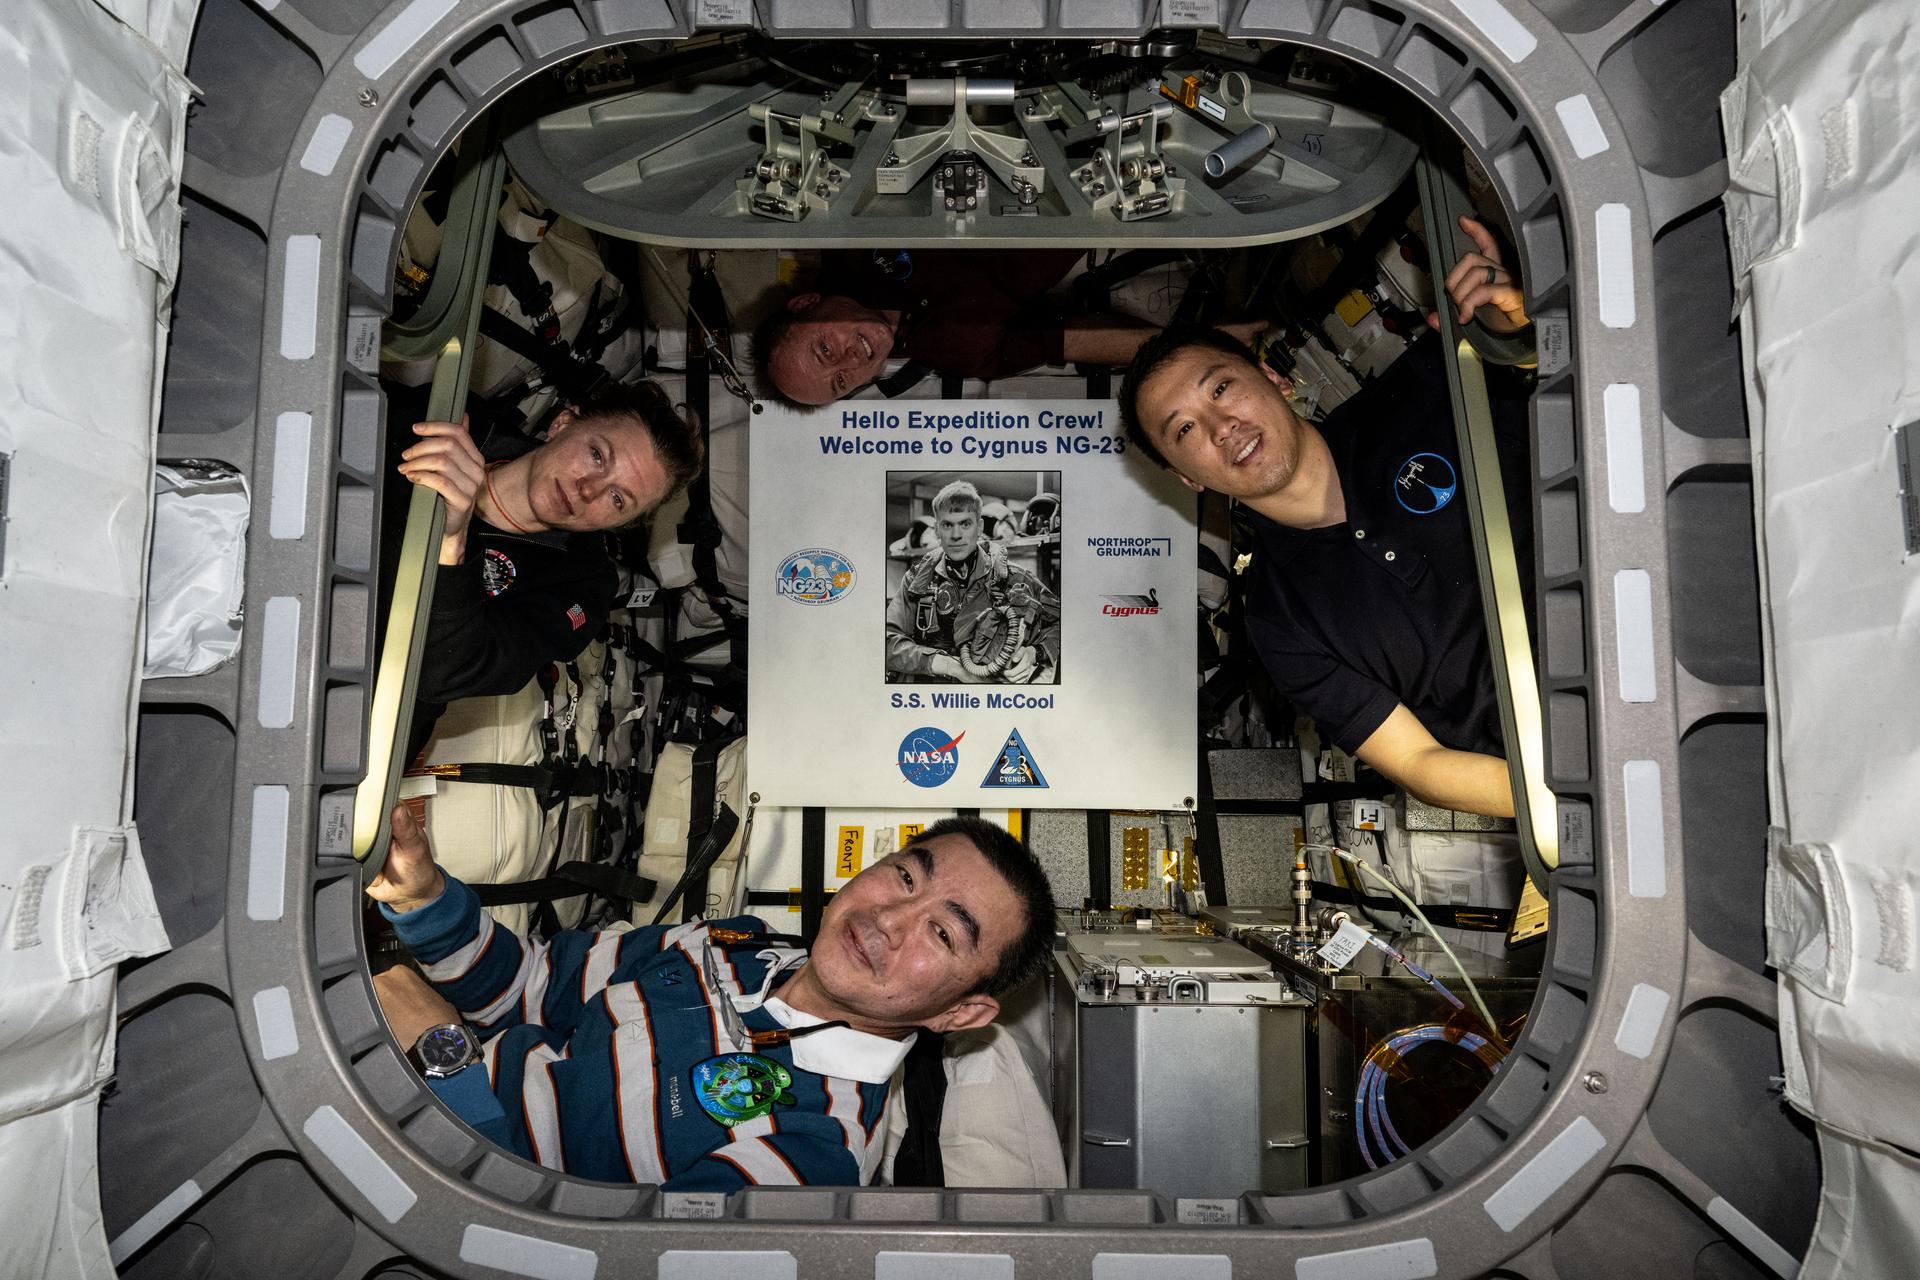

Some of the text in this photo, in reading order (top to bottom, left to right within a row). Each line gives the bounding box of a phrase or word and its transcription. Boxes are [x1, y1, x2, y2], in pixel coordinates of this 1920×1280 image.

[842, 410, 1103, 433] Hello Expedition Crew!
[819, 436, 1126, 459] Welcome to Cygnus NG-23
[1087, 537, 1152, 547] NORTHROP
[1096, 547, 1161, 557] GRUMMAN
[777, 577, 827, 595] NG-23
[1102, 604, 1159, 618] Cygnus
[890, 692, 1054, 709] S.S. Willie McCool
[903, 750, 956, 764] NASA
[1000, 755, 1028, 775] 23
[1360, 808, 1379, 823] F1
[841, 830, 859, 873] FRONT
